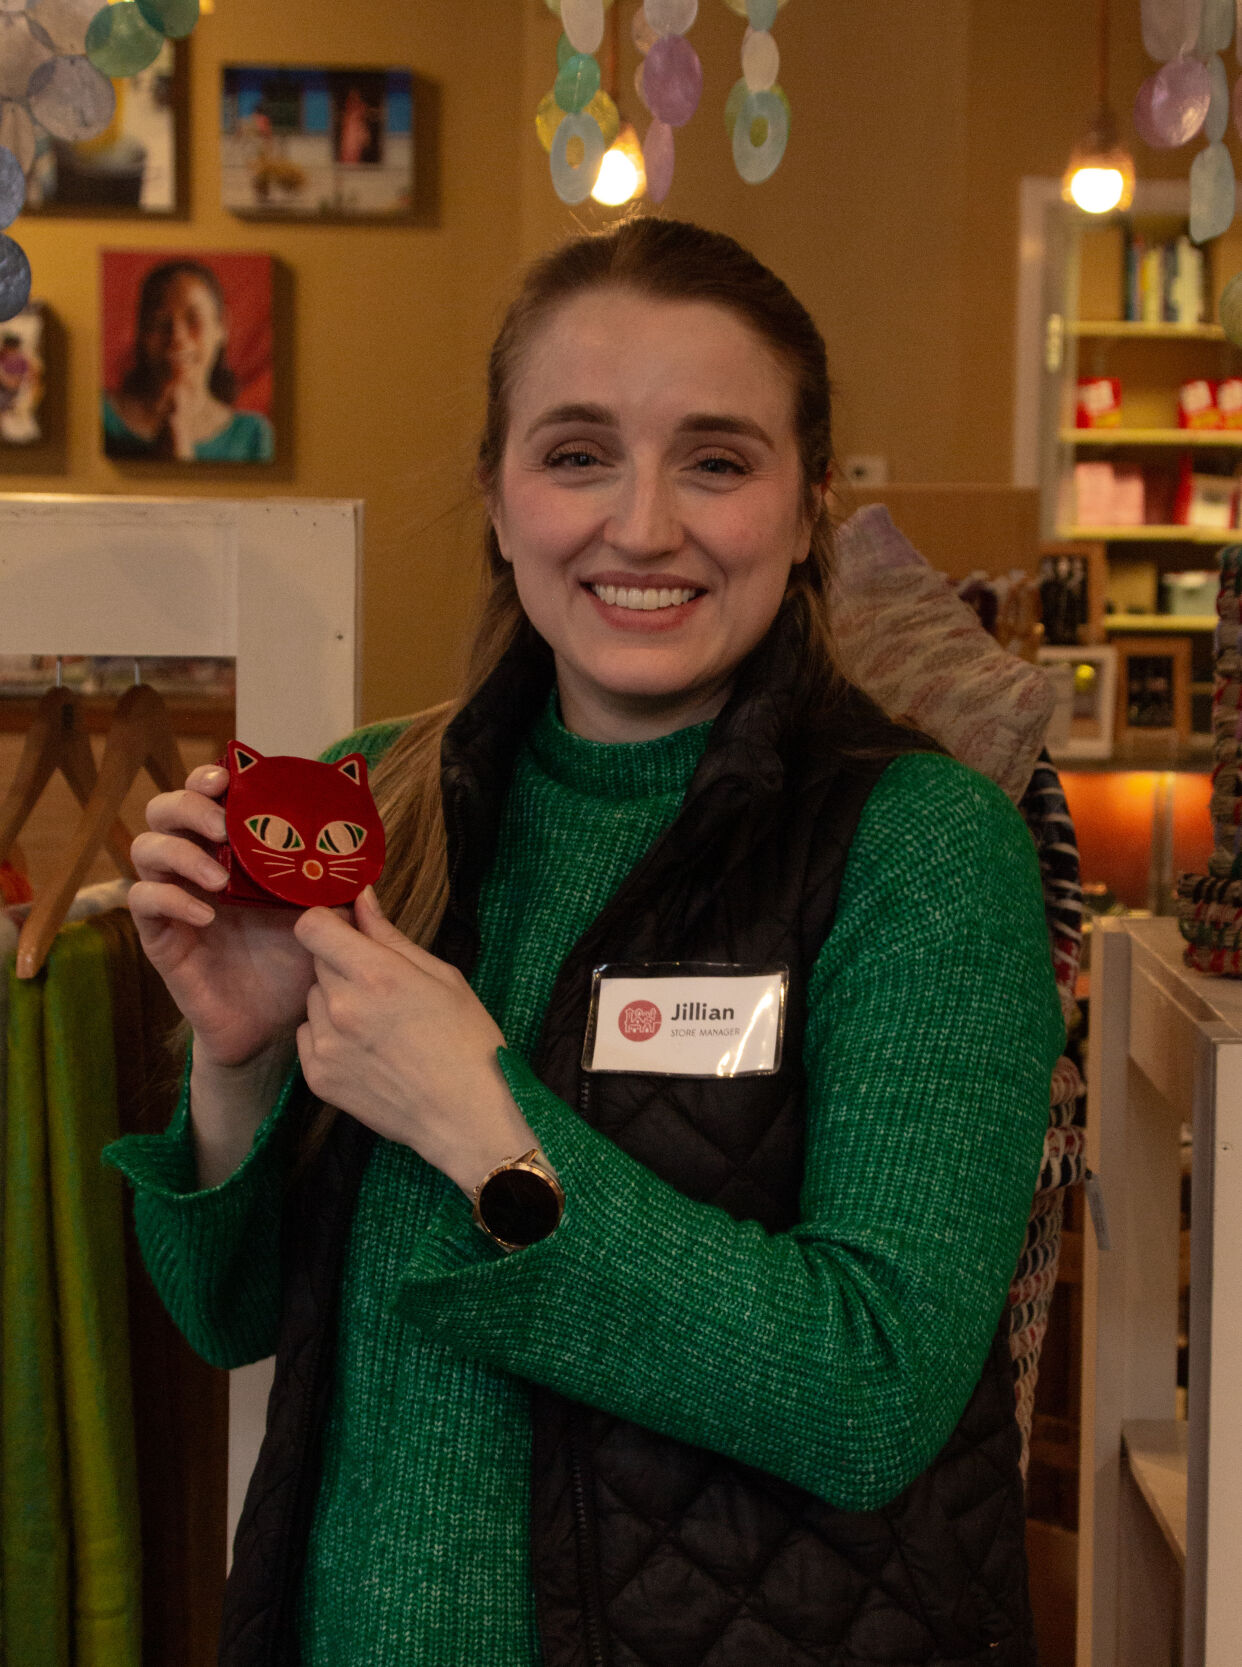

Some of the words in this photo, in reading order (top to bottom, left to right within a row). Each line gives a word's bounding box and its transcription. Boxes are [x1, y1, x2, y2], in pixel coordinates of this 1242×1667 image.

[671, 1002, 734, 1021] Jillian
[671, 1029, 695, 1037] STORE
[699, 1027, 740, 1037] MANAGER
